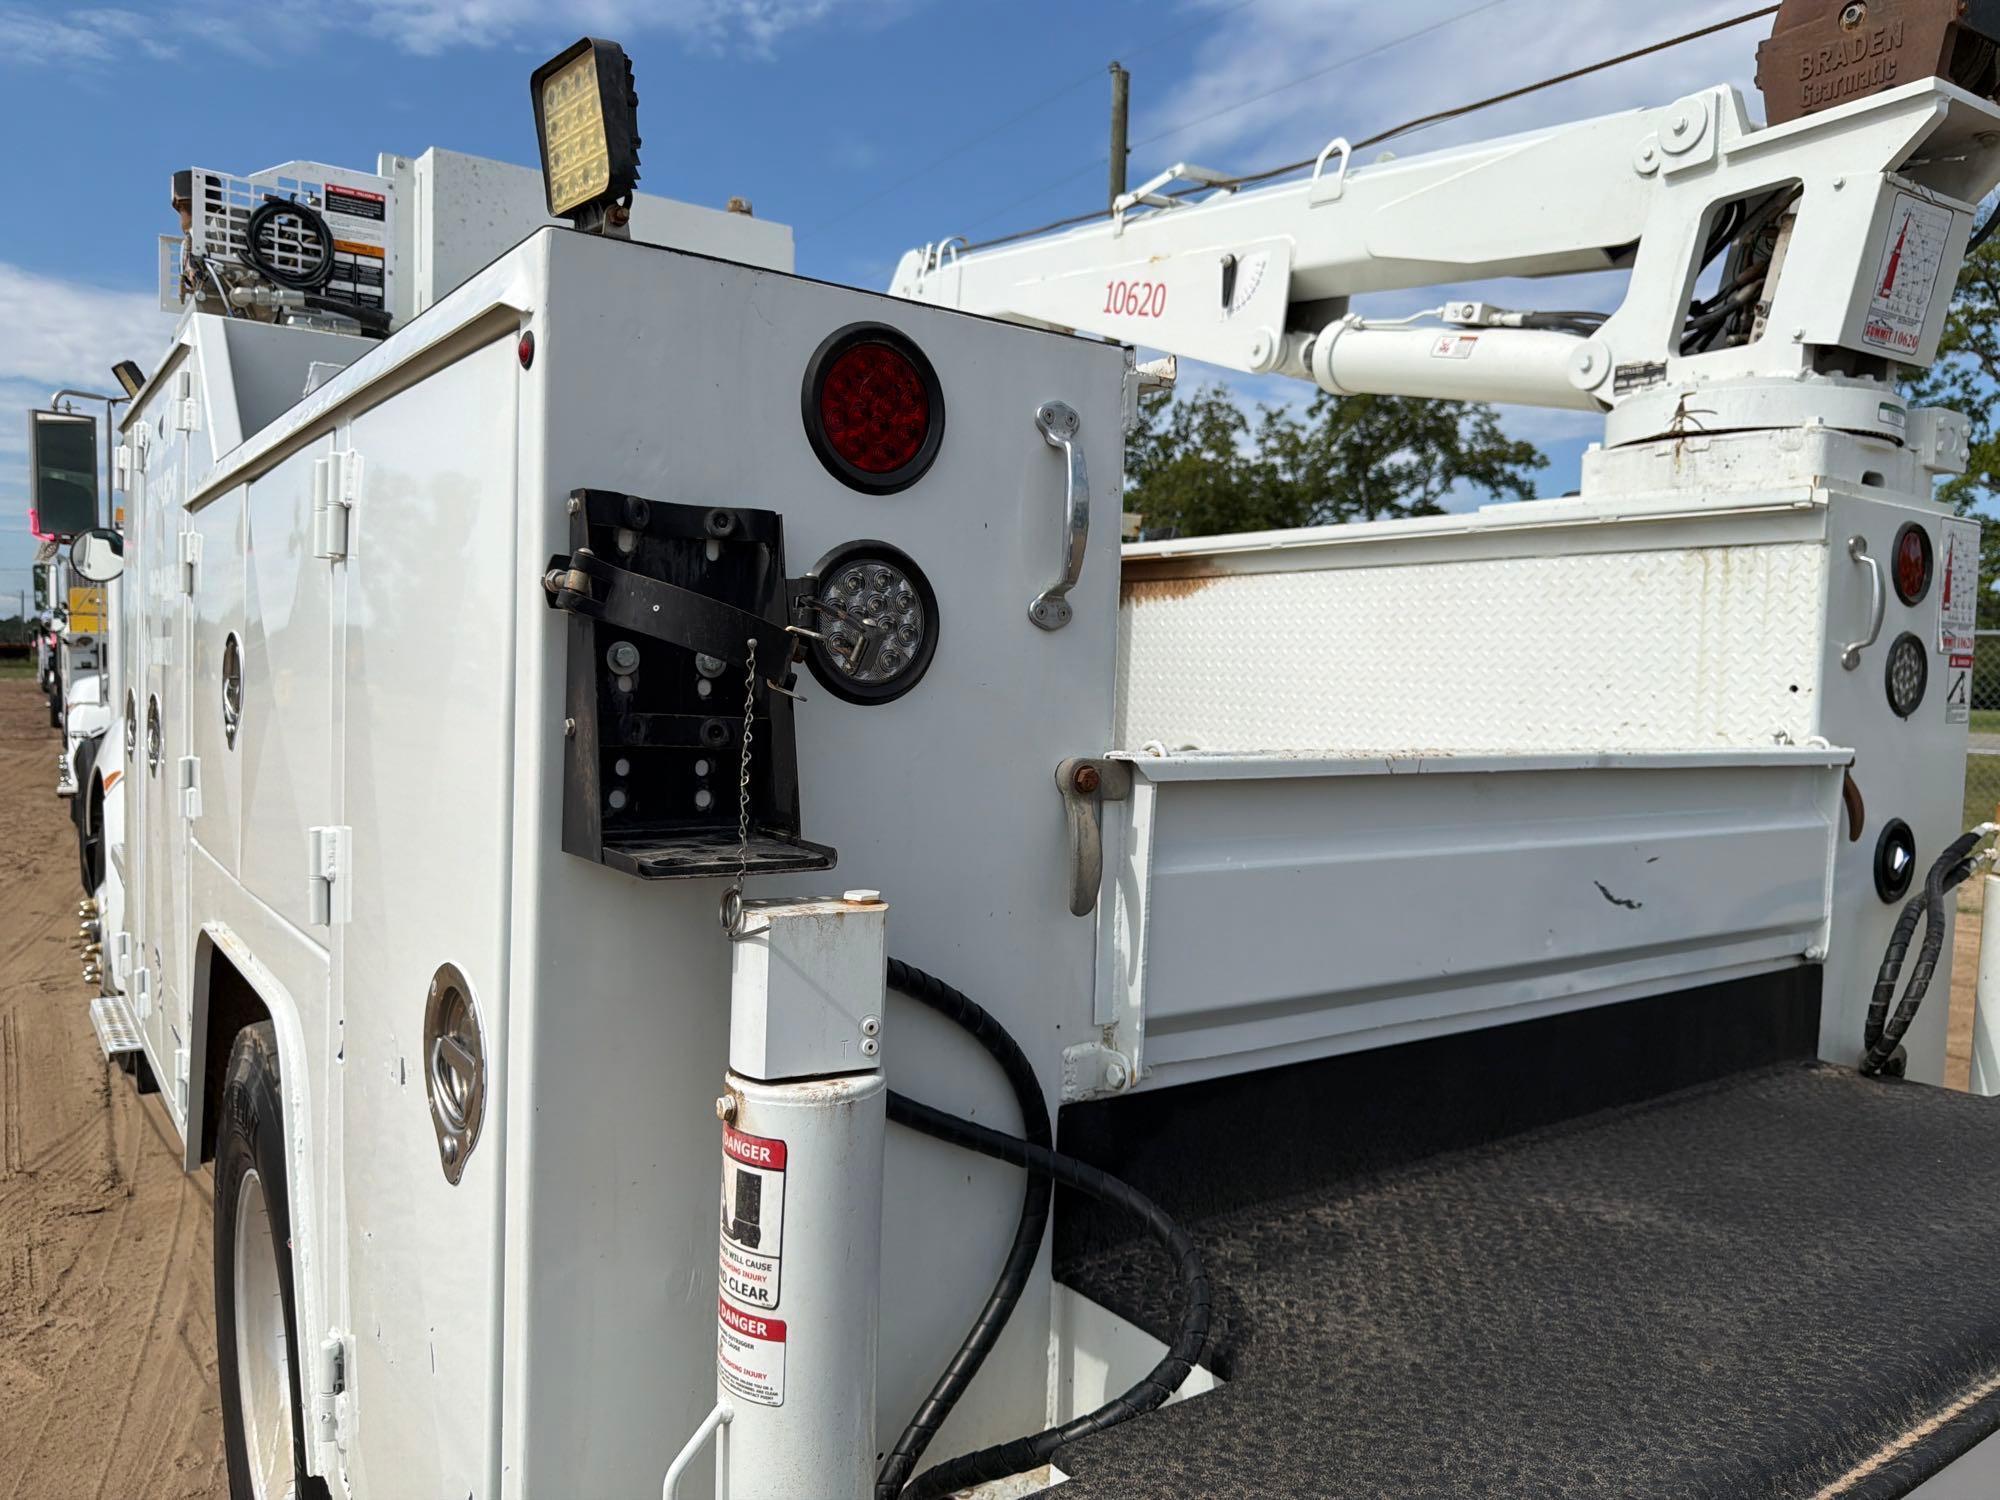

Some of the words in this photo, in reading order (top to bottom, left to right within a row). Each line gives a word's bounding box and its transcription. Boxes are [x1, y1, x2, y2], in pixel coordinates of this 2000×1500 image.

[1799, 19, 1904, 81] BRADEN
[1799, 57, 1897, 108] Gearmatic
[1103, 281, 1166, 318] 10620
[1893, 331, 1920, 348] 10620
[724, 1131, 771, 1163] DANGER
[729, 1250, 743, 1265] WILL
[745, 1258, 772, 1272] CAUSE
[729, 1277, 769, 1302] CLEAR
[742, 1271, 768, 1283] INJURY
[721, 1303, 768, 1336] DANGER
[743, 1368, 767, 1380] INJURY
